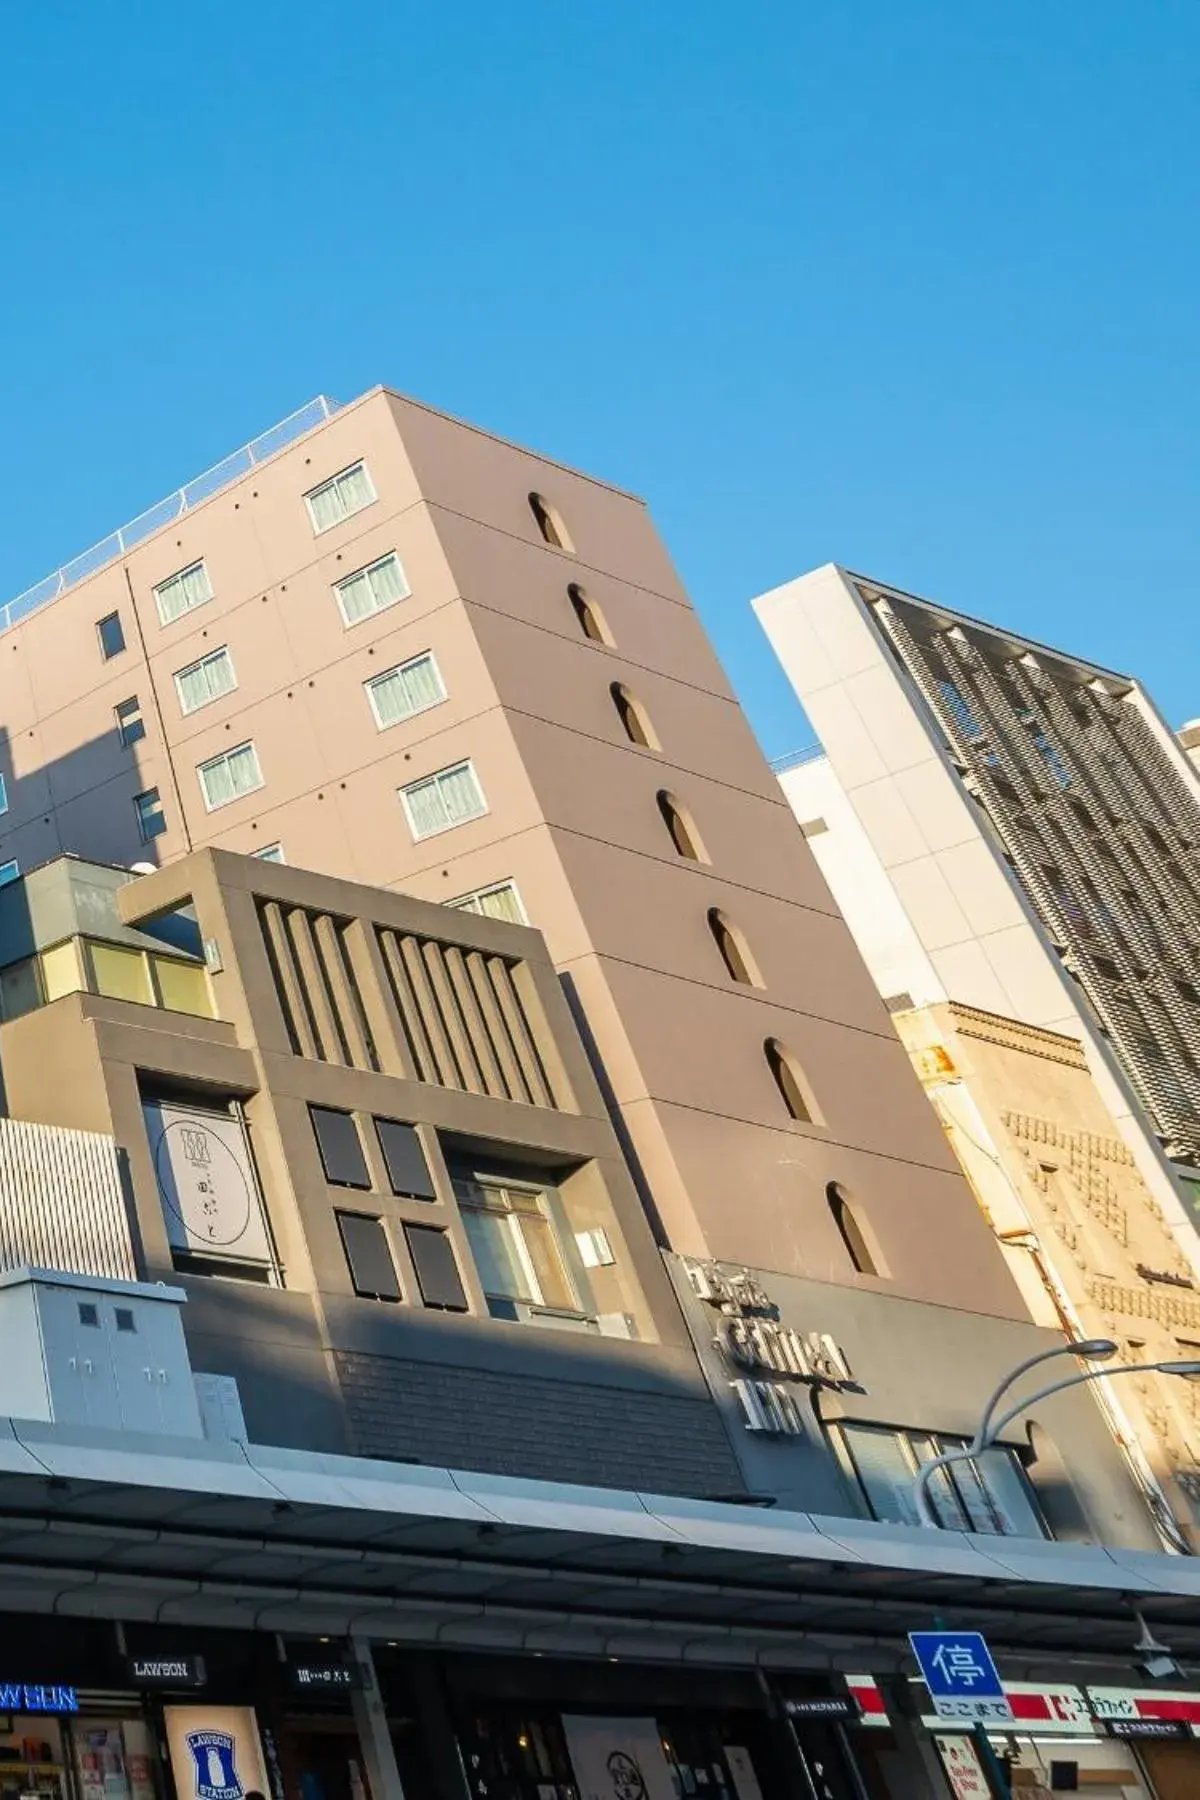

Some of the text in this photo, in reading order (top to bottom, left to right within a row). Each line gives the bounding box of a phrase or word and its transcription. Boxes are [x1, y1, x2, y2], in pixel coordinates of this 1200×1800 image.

[133, 1661, 188, 1677] LAWSON
[931, 1643, 986, 1686] 停
[938, 1702, 1008, 1717] ここまで
[189, 1734, 232, 1750] LAWSON
